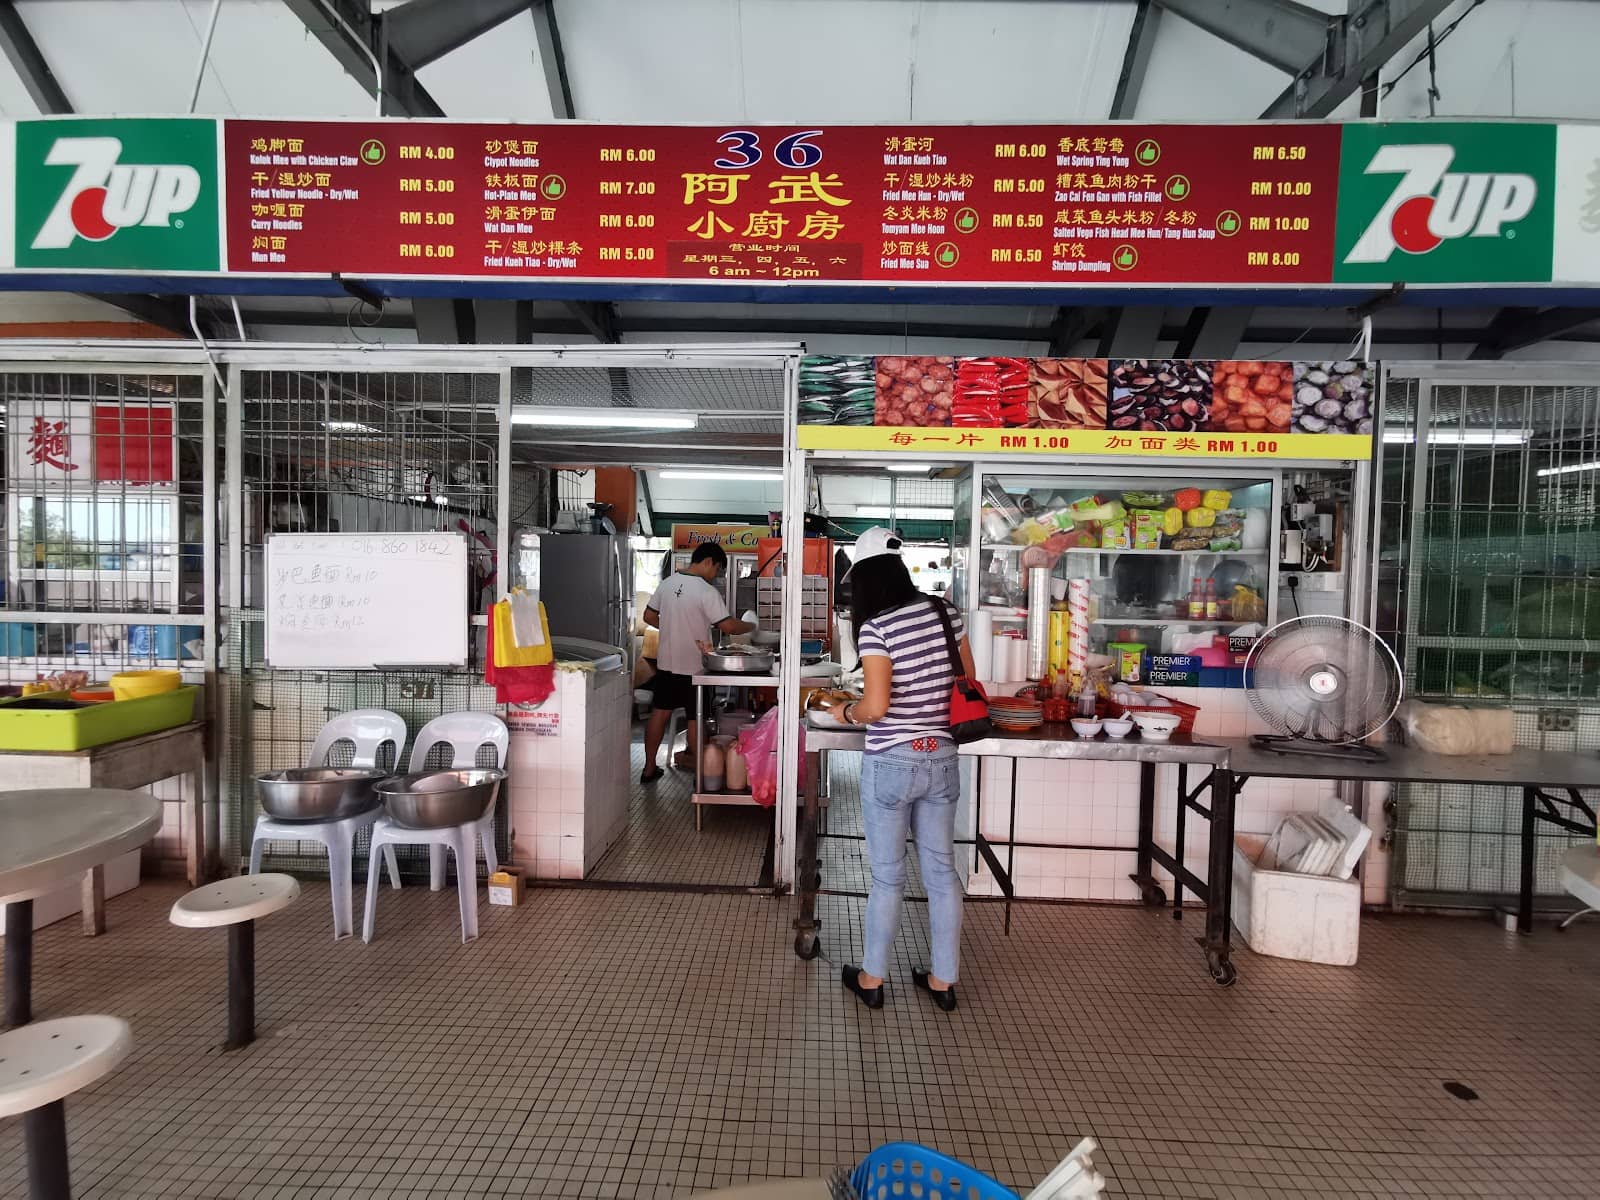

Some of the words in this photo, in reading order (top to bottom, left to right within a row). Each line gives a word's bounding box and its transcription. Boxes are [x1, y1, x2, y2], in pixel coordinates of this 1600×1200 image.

[251, 138, 304, 153] 鸡脚面
[714, 131, 823, 169] 36
[885, 137, 934, 152] 滑蛋河
[995, 144, 1016, 158] RM
[1019, 144, 1047, 158] 6.00
[400, 146, 421, 159] RM
[426, 146, 454, 160] 4.00
[600, 149, 622, 161] RM
[626, 149, 656, 162] 6.00
[899, 154, 912, 166] Dan
[1253, 146, 1274, 160] RM
[1278, 146, 1306, 161] 6.50
[308, 155, 338, 166] Chicken
[400, 179, 421, 192] RM
[426, 179, 454, 193] 5.00
[485, 173, 539, 188] 铁板面
[993, 179, 1014, 193] RM
[1017, 179, 1045, 193] 5.00
[251, 188, 270, 199] Fried
[271, 188, 296, 199] Yellow
[600, 182, 622, 194] RM
[626, 182, 655, 195] 7.00
[681, 172, 852, 206] 阿武
[883, 190, 900, 201] Fried
[1251, 182, 1272, 196] RM
[1276, 182, 1312, 196] 10.00
[1128, 190, 1143, 202] Fish
[400, 212, 421, 225] RM
[426, 212, 454, 225] 5.00
[485, 206, 556, 221] 滑蛋伊面
[883, 205, 948, 221] 冬炎米粉
[251, 219, 271, 230] Curry
[500, 222, 515, 233] Dan
[600, 215, 621, 227] RM
[625, 215, 655, 228] 6.00
[992, 214, 1013, 228] RM
[1016, 214, 1044, 228] 6.50
[1249, 217, 1270, 231] RM
[1275, 217, 1309, 231] 10.00
[1095, 227, 1110, 239] Fish
[400, 244, 421, 257] RM
[426, 244, 454, 258] 6.00
[599, 247, 621, 260] RM
[625, 247, 654, 261] 5.00
[882, 240, 931, 256] 炒面线
[1053, 243, 1086, 258] 虾饺
[484, 256, 503, 267] Fried
[991, 249, 1012, 262] RM
[1015, 249, 1042, 263] 6.50
[1248, 252, 1269, 266] RM
[1272, 252, 1300, 266] 8.00
[881, 258, 898, 269] Fried
[709, 267, 719, 276] 6
[724, 268, 751, 276] am
[772, 267, 819, 278] 12pm
[888, 431, 985, 447] 每一片
[1000, 436, 1027, 449] RM
[1033, 436, 1069, 449] 1.00
[1105, 435, 1201, 451] 加面类
[1207, 440, 1235, 453] RM
[1241, 440, 1279, 454] 1.00
[1153, 656, 1190, 666] PREMIER
[1150, 671, 1187, 681] PREMIER
